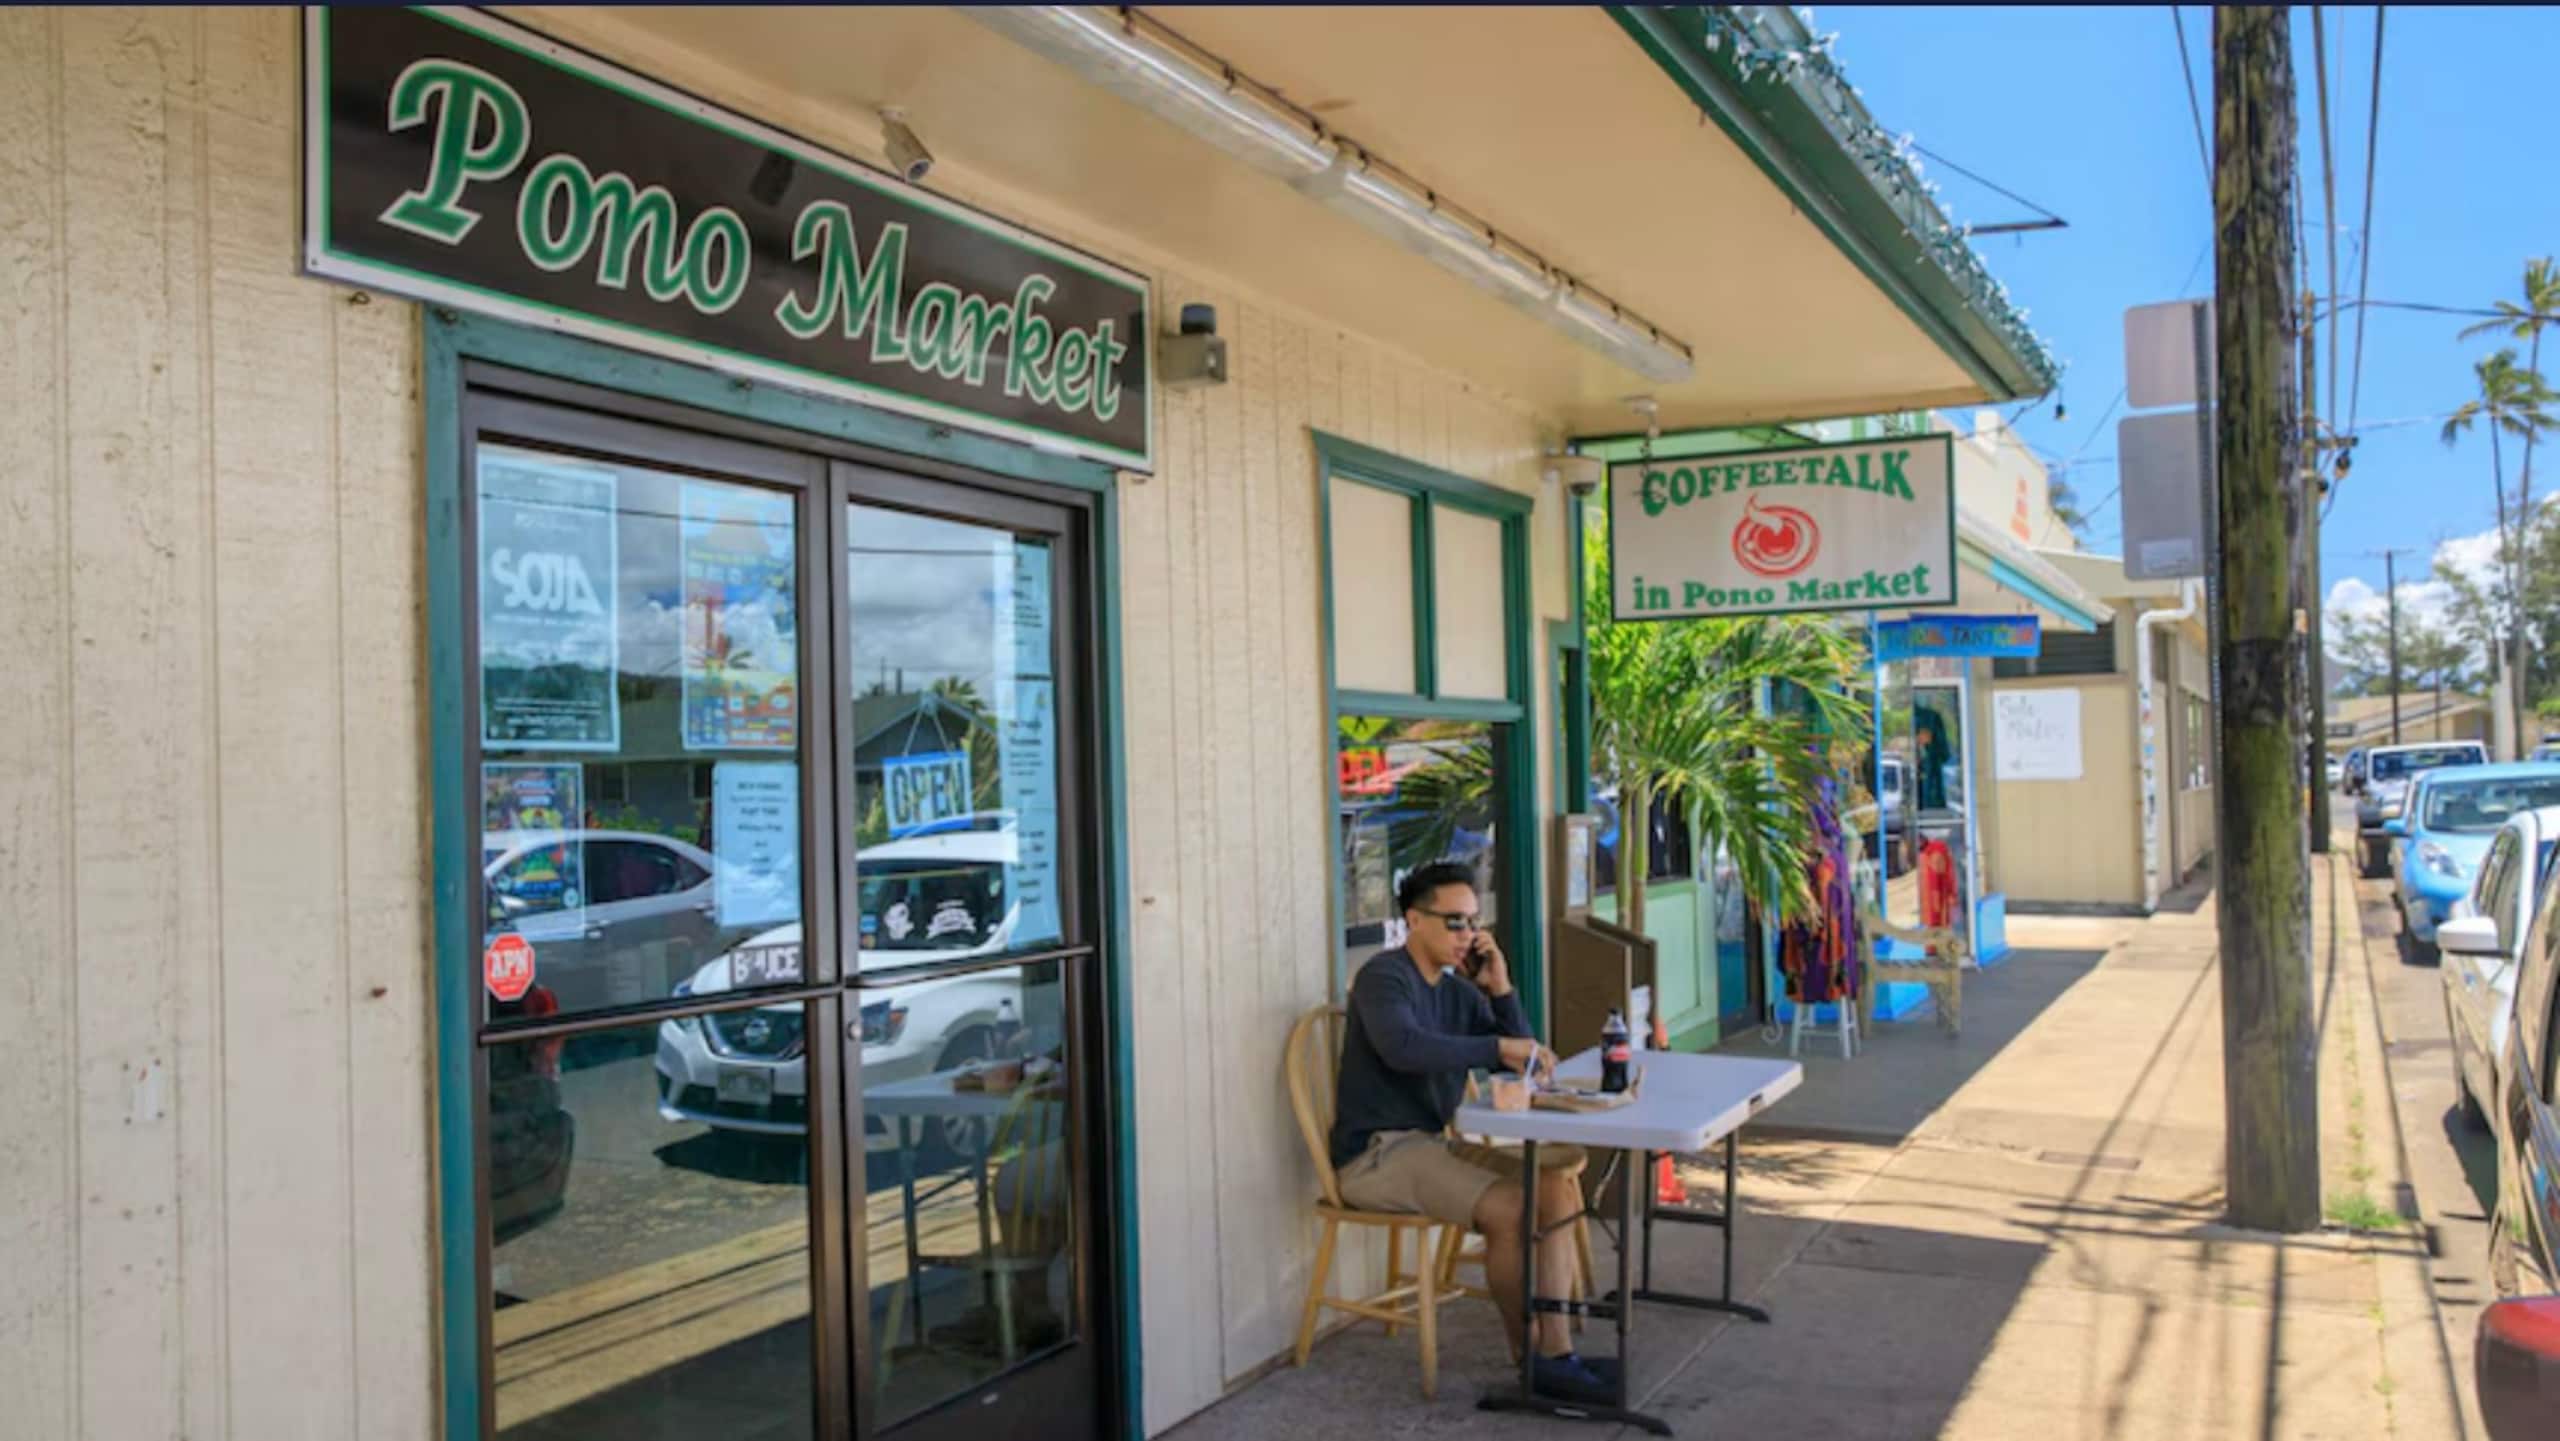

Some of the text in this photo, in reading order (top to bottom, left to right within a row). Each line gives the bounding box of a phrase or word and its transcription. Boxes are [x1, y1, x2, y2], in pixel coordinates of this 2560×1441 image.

[379, 58, 1126, 421] Pono Market
[1641, 449, 1915, 517] COFFEETALK
[1633, 563, 1930, 610] in Pono Market
[892, 760, 966, 825] OPEN
